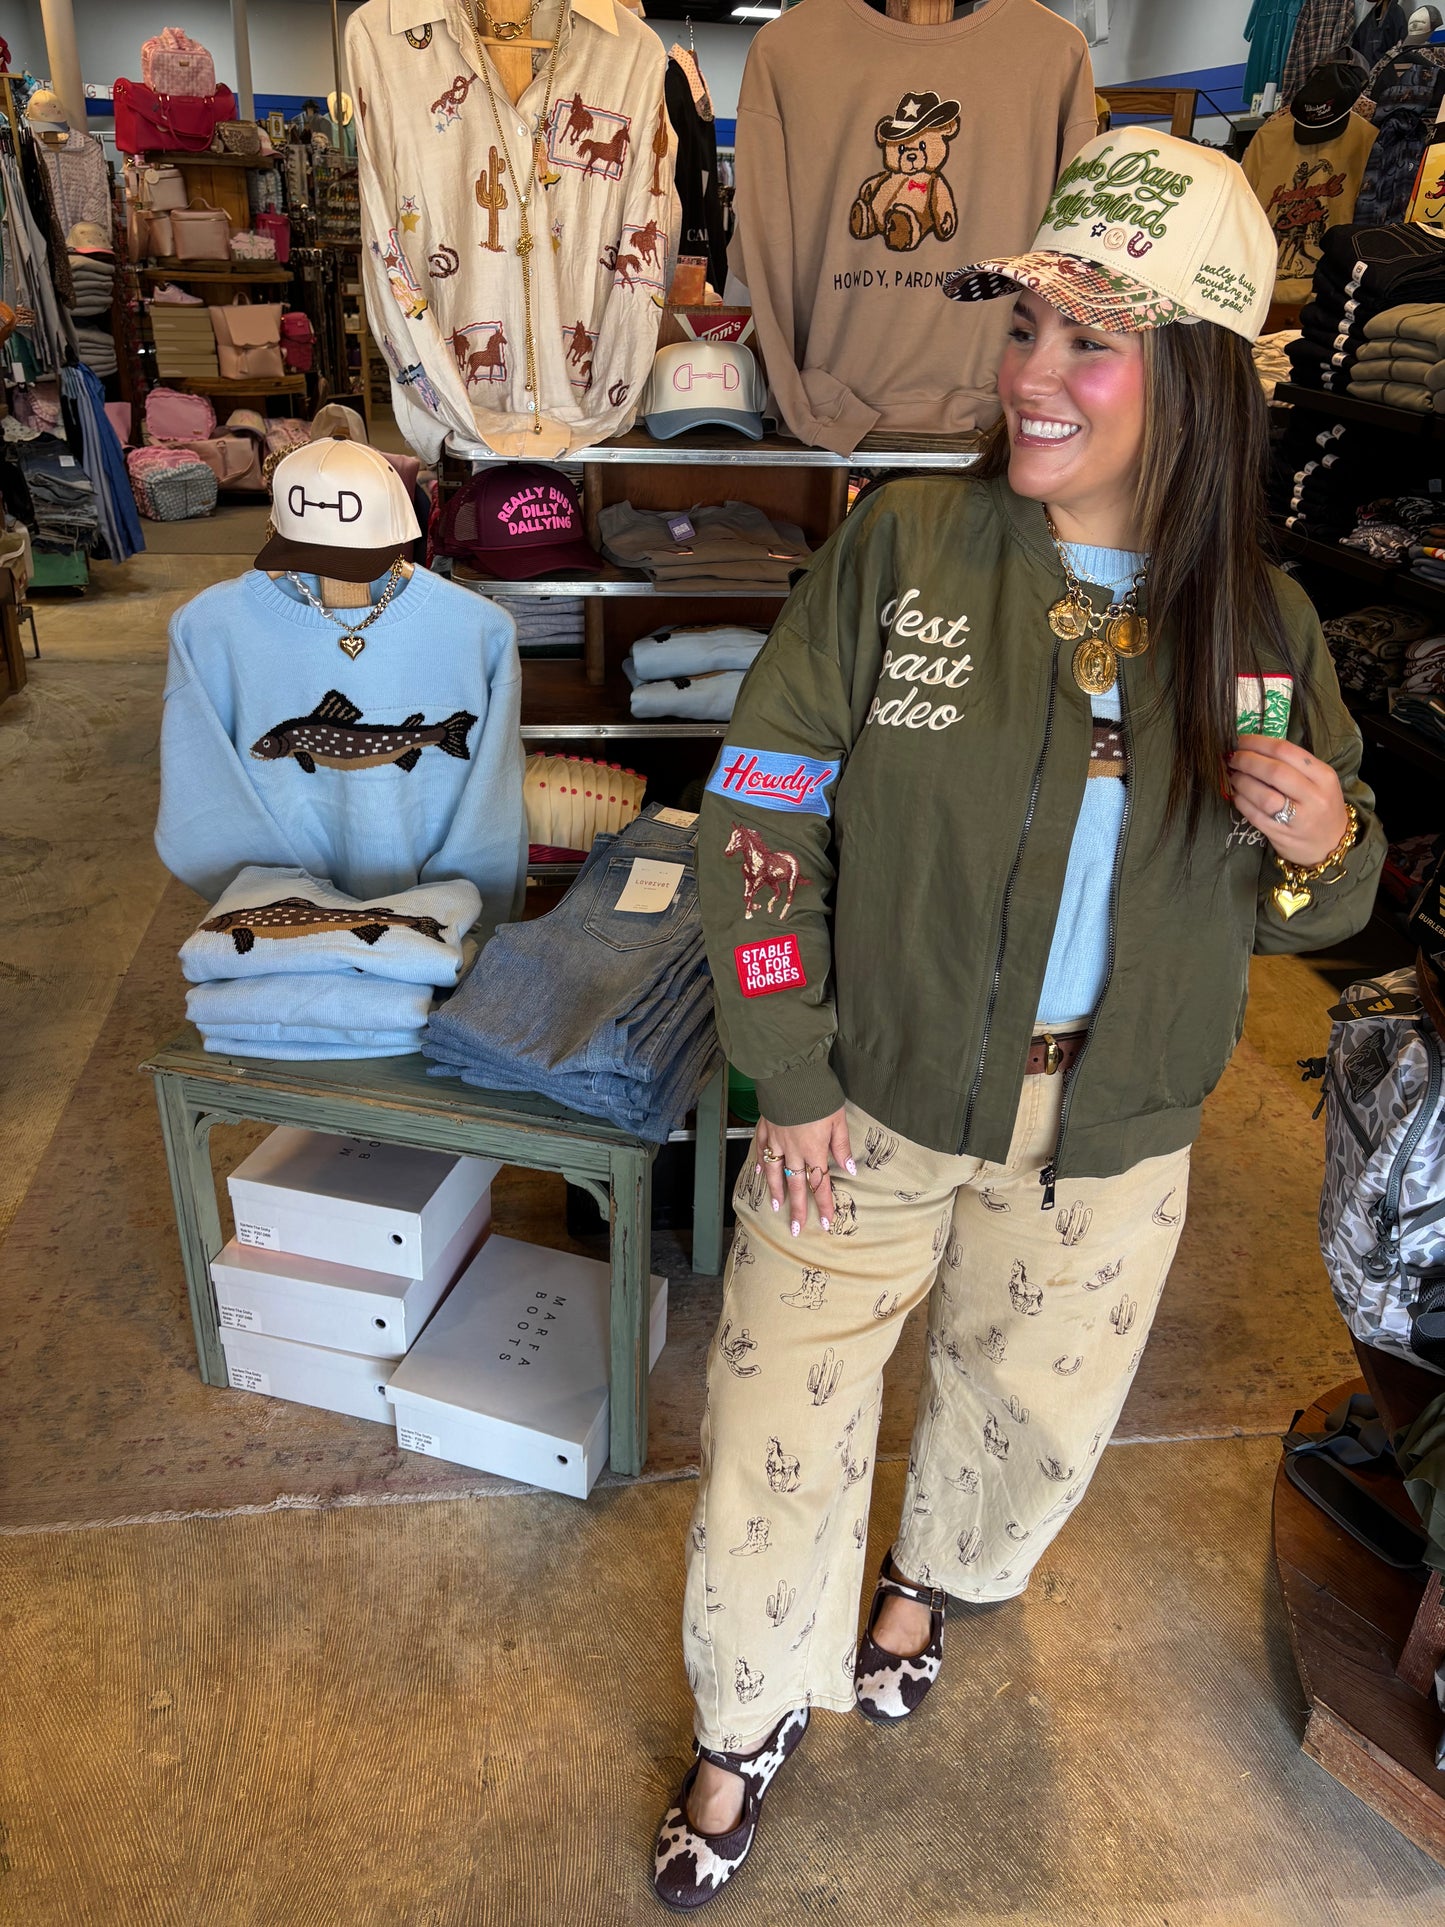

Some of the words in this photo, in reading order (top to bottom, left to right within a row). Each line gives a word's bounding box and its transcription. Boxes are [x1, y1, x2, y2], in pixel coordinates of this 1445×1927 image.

[1093, 149, 1193, 201] Days
[1081, 193, 1179, 239] Mind
[834, 269, 888, 290] HOWDY,
[895, 270, 953, 288] PARDN
[1192, 272, 1242, 301] focusing
[1243, 294, 1252, 306] on
[1199, 263, 1237, 287] really
[1238, 273, 1256, 297] busy
[1201, 288, 1221, 302] the
[1219, 298, 1245, 313] good
[701, 320, 741, 342] Tom's
[497, 486, 545, 523] REALLY
[549, 487, 574, 515] BUSY
[521, 503, 559, 518] DILLY
[508, 516, 572, 535] DALLYING
[866, 686, 965, 731] odeo
[723, 753, 832, 805] Howdy!
[1418, 912, 1445, 938] BURLEB
[742, 940, 793, 964] STABLE
[748, 962, 761, 977] IS
[765, 956, 791, 973] FOR
[746, 967, 800, 990] HORSES
[499, 1291, 548, 1361] BOOTS
[518, 1295, 567, 1366] MARFA
